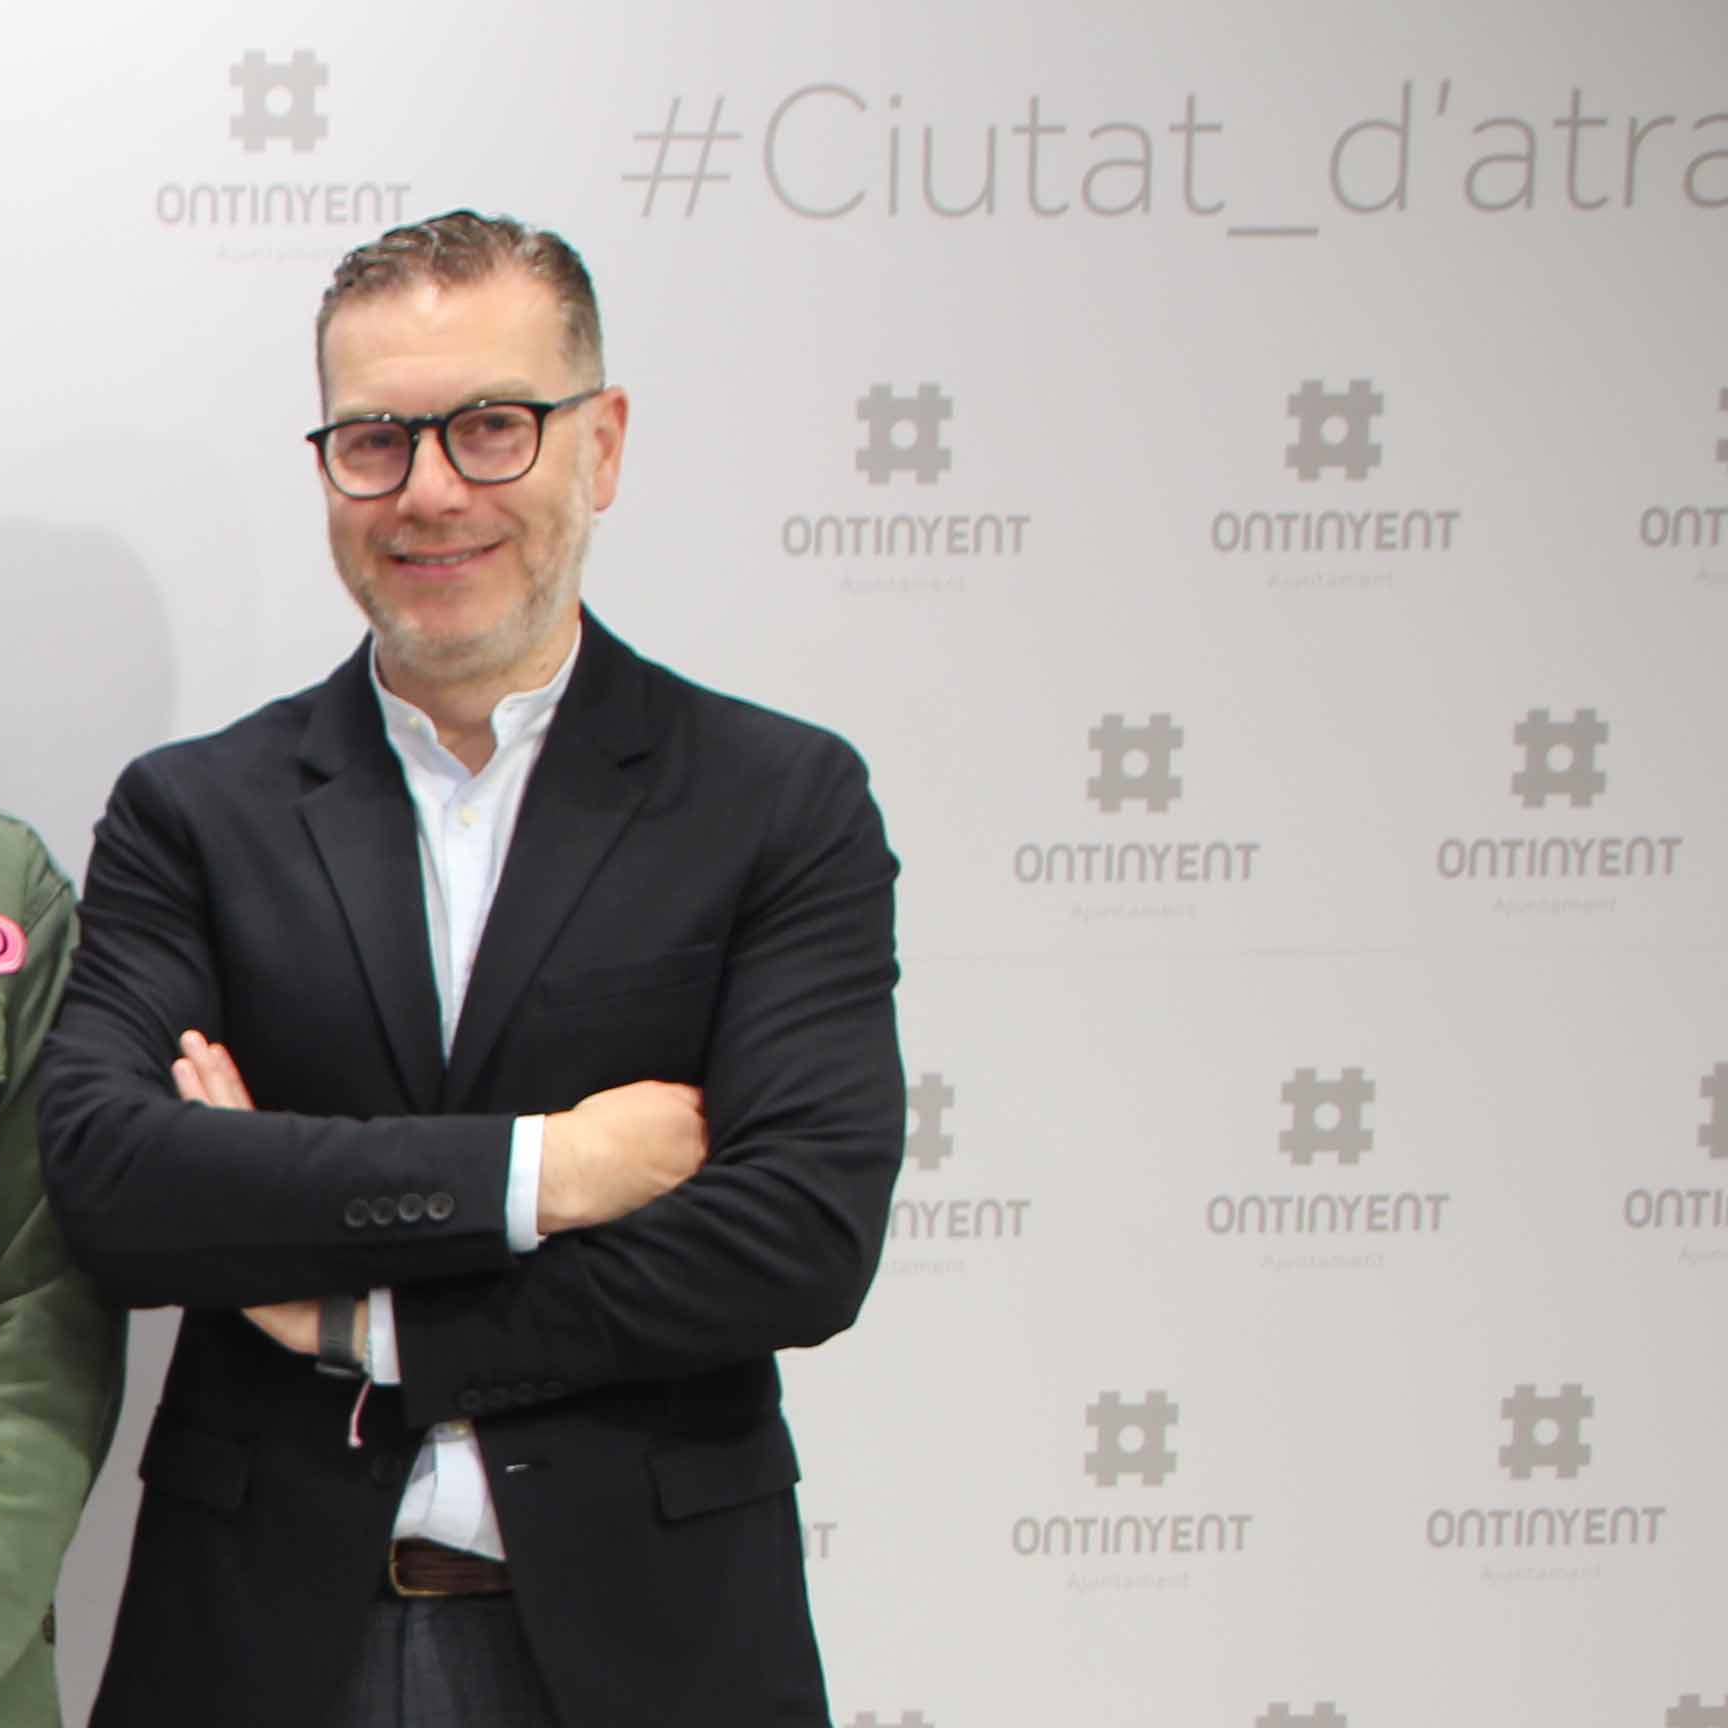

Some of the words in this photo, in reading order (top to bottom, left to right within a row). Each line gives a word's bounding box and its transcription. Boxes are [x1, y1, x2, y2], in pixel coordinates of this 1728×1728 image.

[156, 182, 411, 225] ONTINYENT
[782, 514, 1031, 557] ONTINYENT
[1211, 509, 1461, 553] ONTINYENT
[1014, 841, 1260, 884] ONTINYENT
[1437, 836, 1683, 879] ONTINYENT
[1206, 1193, 1450, 1235] ONTINYENT
[1012, 1513, 1253, 1556] ONTINYENT
[1426, 1506, 1666, 1548] ONTINYENT
